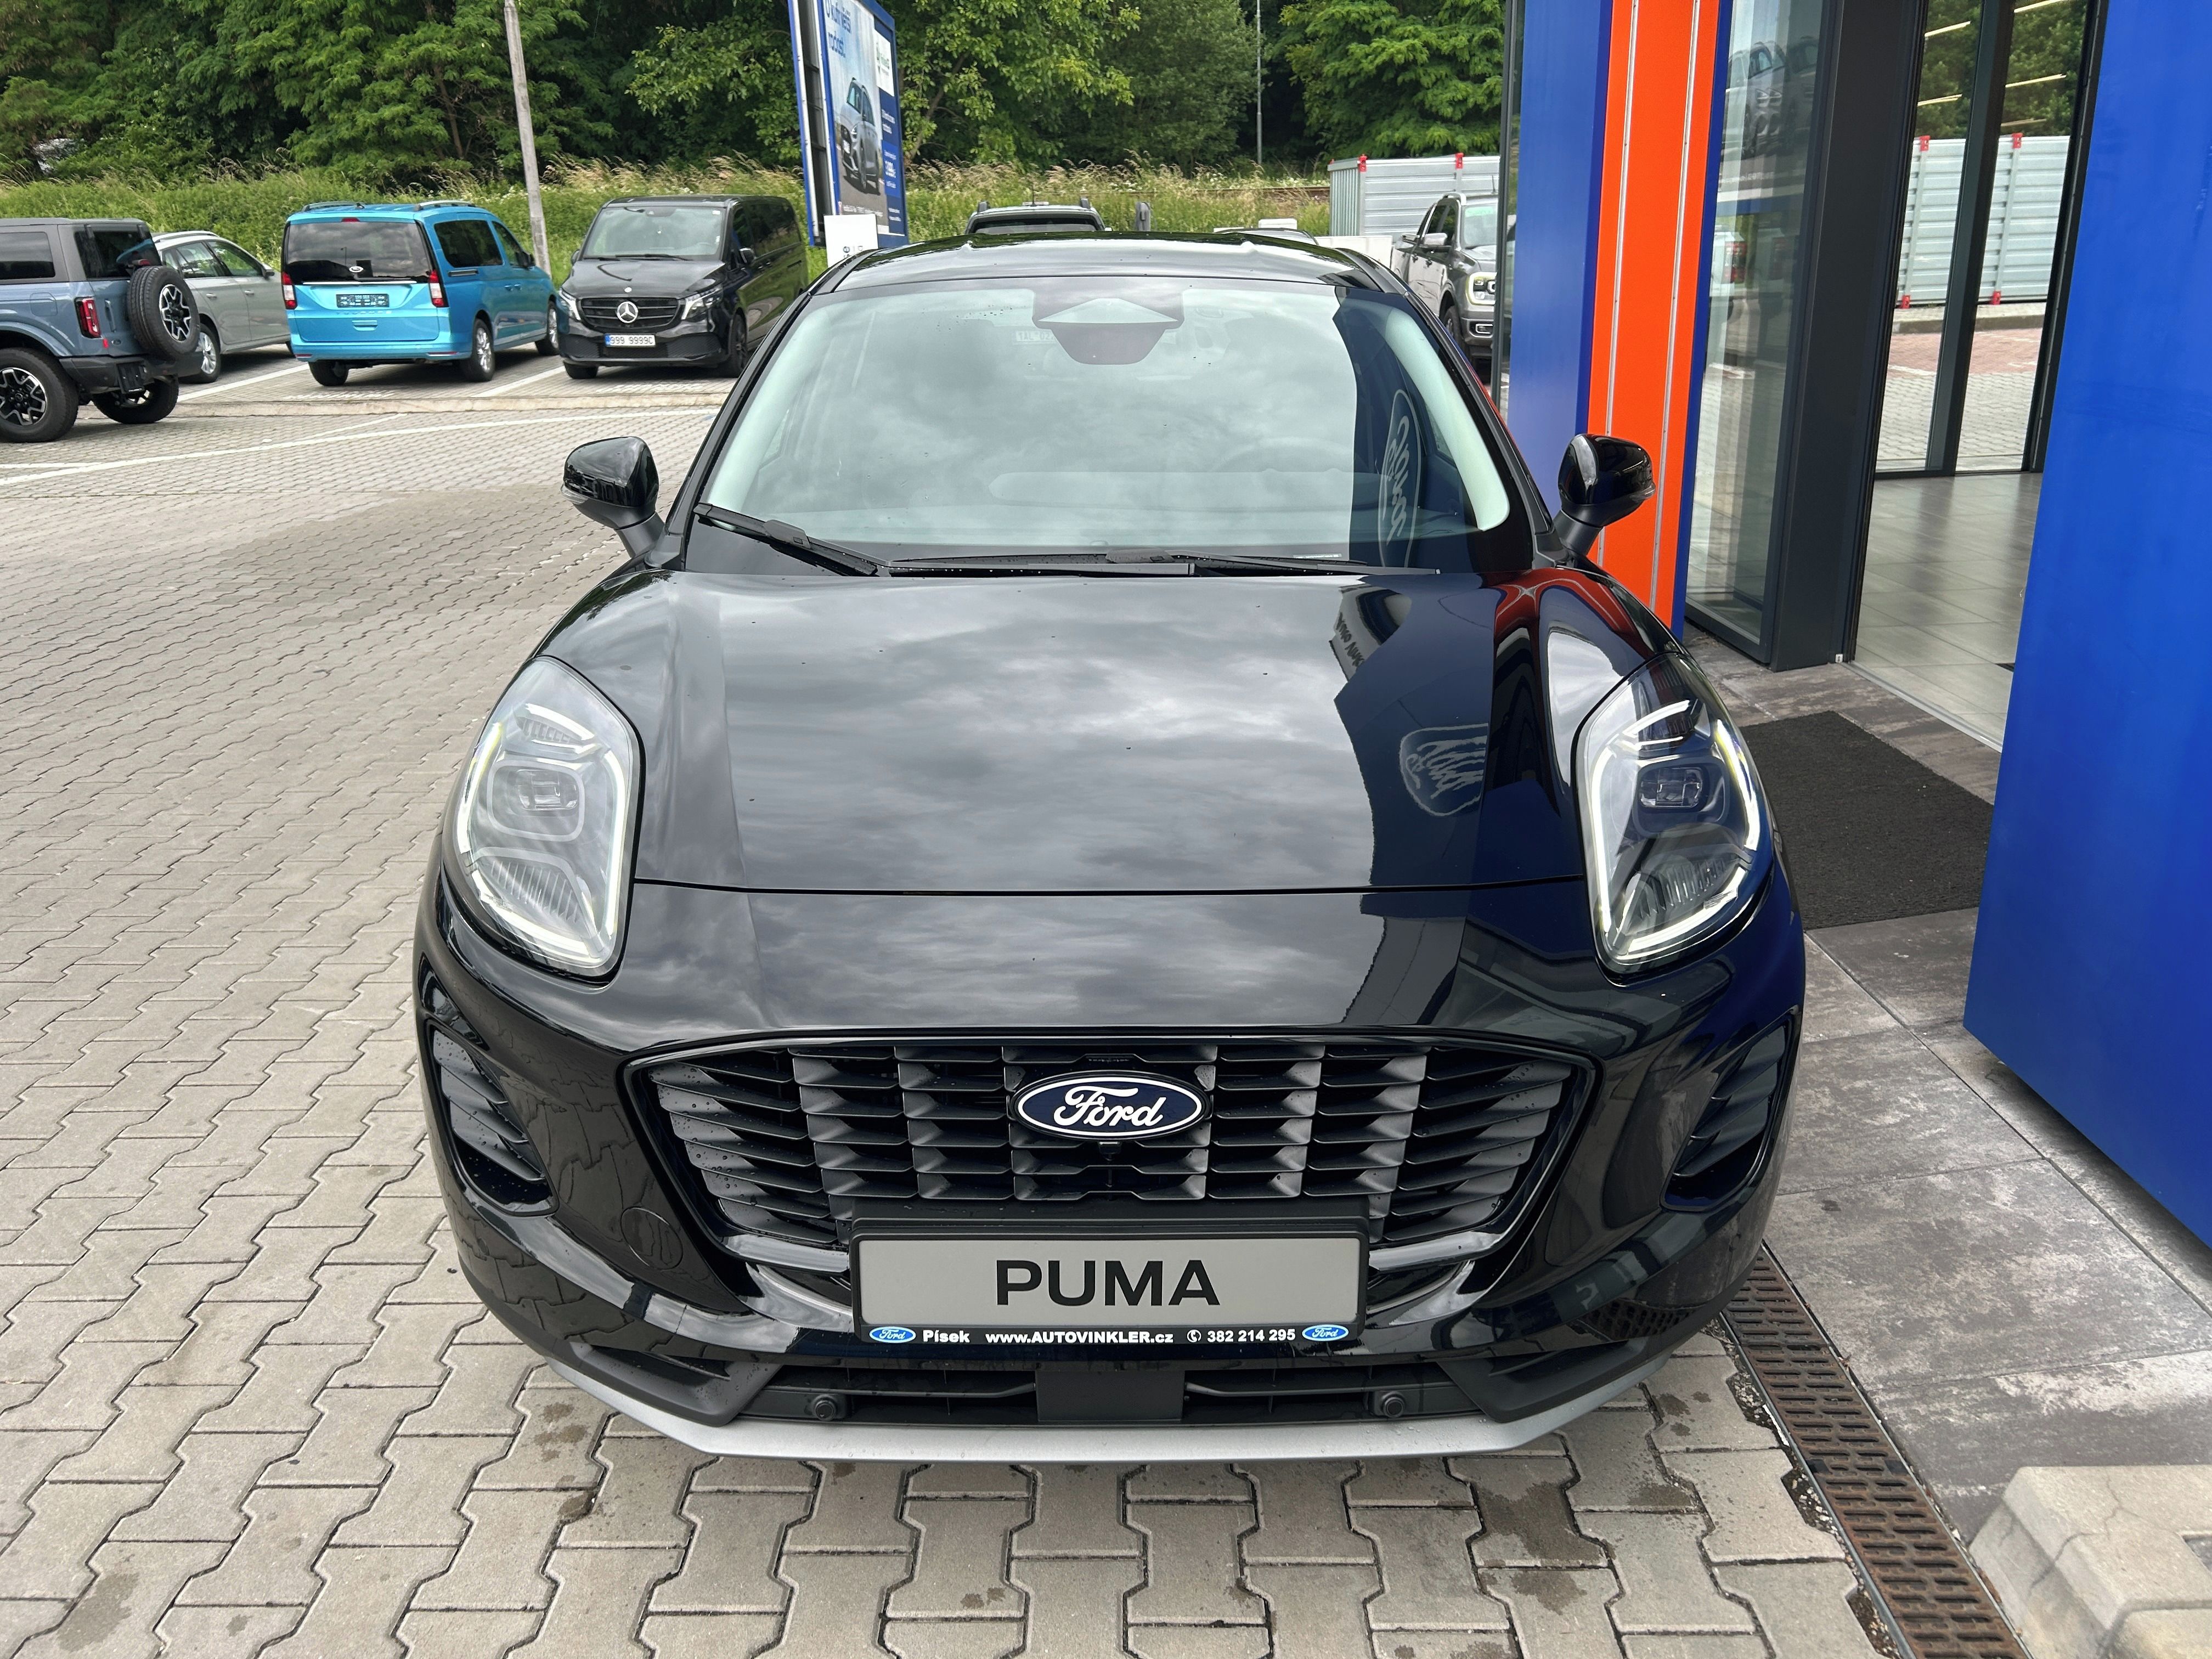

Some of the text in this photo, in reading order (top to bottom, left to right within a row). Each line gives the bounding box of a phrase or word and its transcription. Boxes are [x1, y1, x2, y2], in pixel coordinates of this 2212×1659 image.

[1053, 1085, 1166, 1127] Ford
[996, 1260, 1221, 1306] PUMA
[879, 1327, 1339, 1344] Ford Písek www.AUTOVINKLER.cz 382 214 295 Ford
